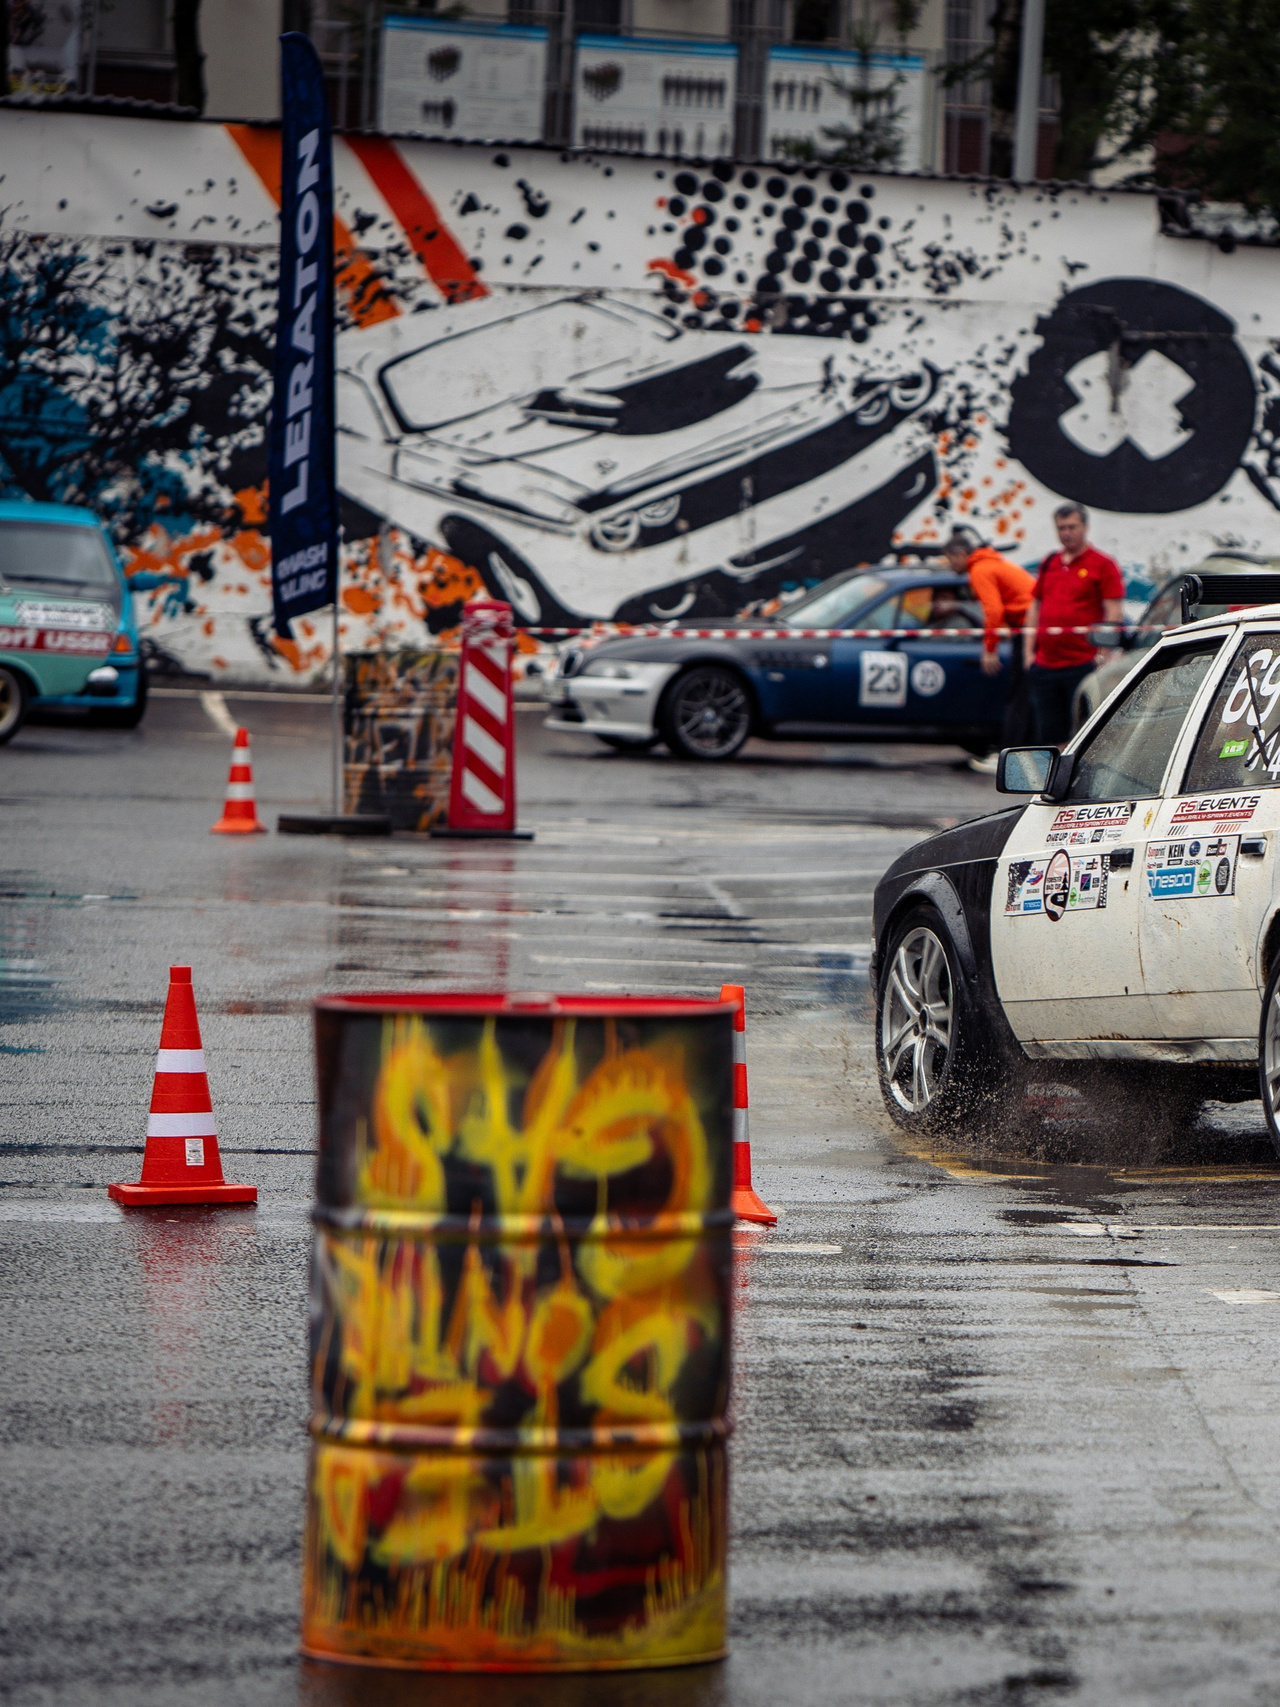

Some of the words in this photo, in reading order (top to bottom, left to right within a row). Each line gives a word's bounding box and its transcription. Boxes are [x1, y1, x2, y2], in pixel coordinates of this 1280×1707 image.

[280, 127, 320, 515] LERATON
[868, 664, 900, 693] 23
[1199, 796, 1261, 811] EVENTS
